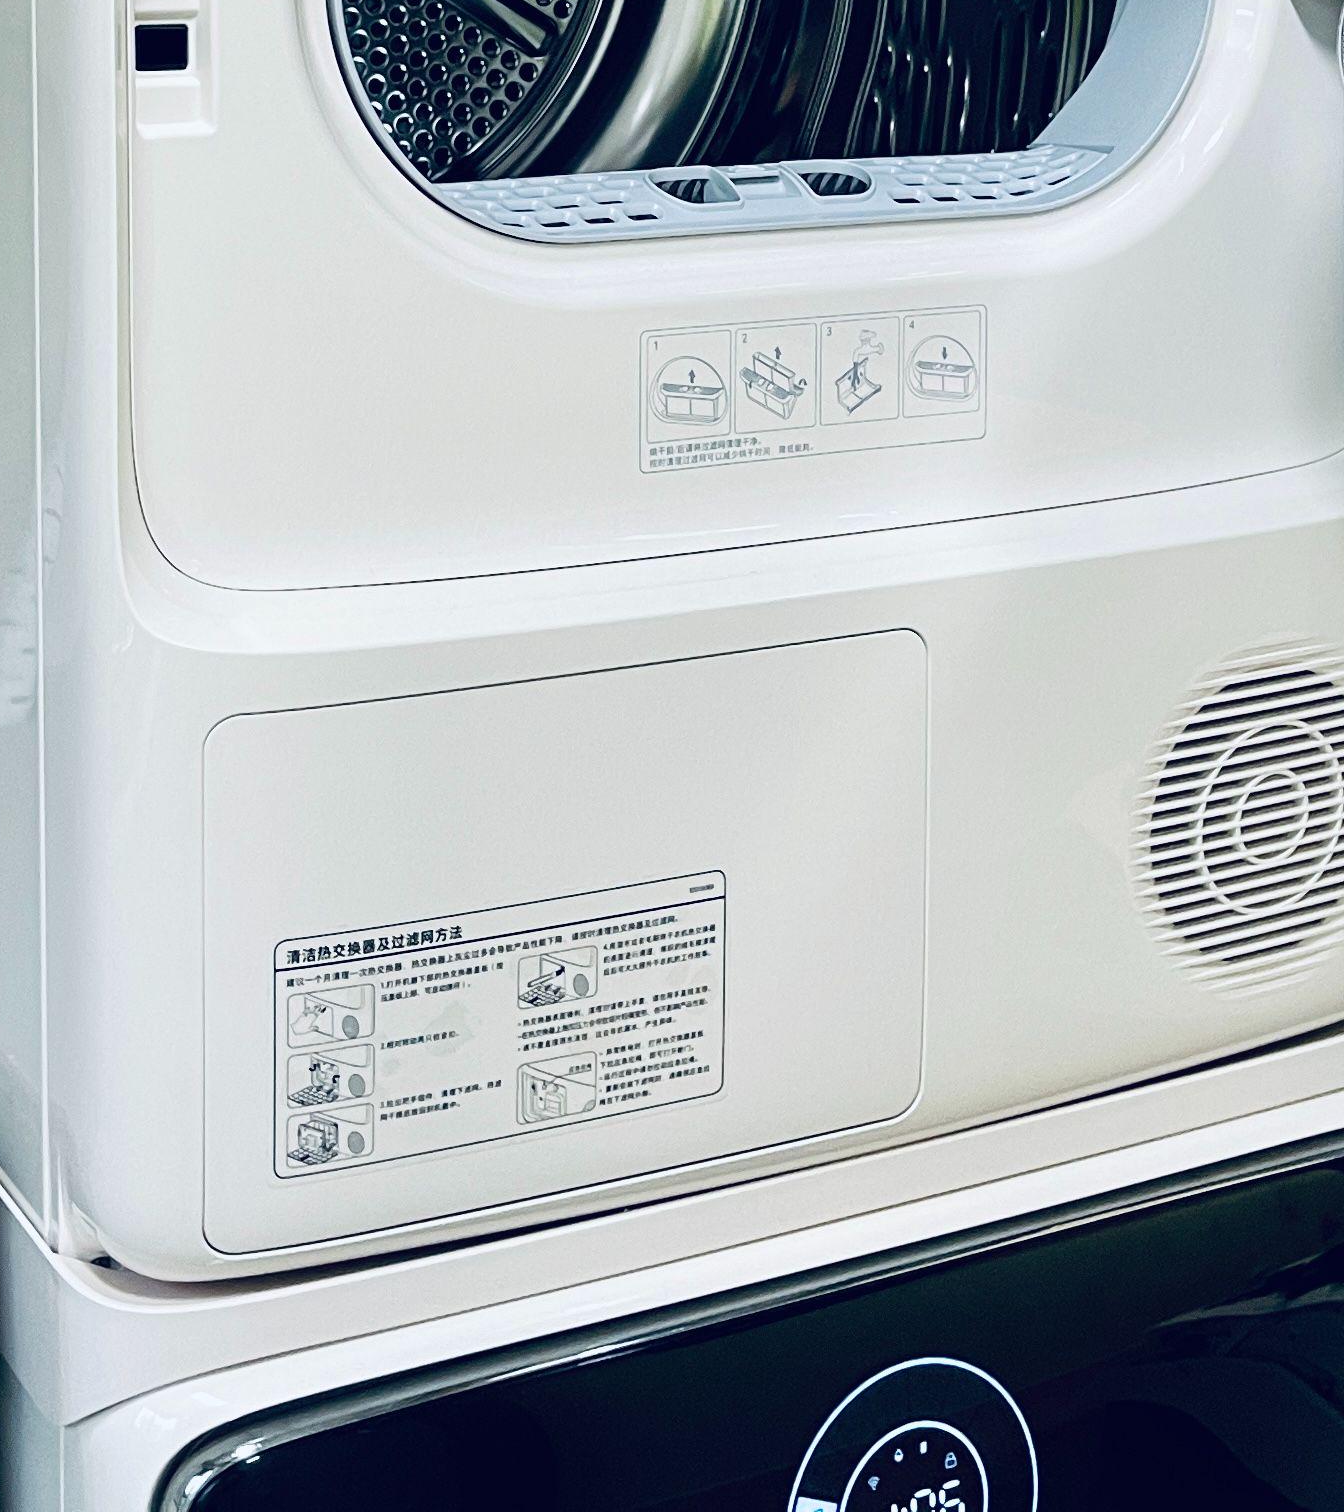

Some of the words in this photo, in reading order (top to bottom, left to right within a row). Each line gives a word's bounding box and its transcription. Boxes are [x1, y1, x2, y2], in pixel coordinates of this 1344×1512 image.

[286, 925, 463, 965] 清洁热交换器及过滤网方法
